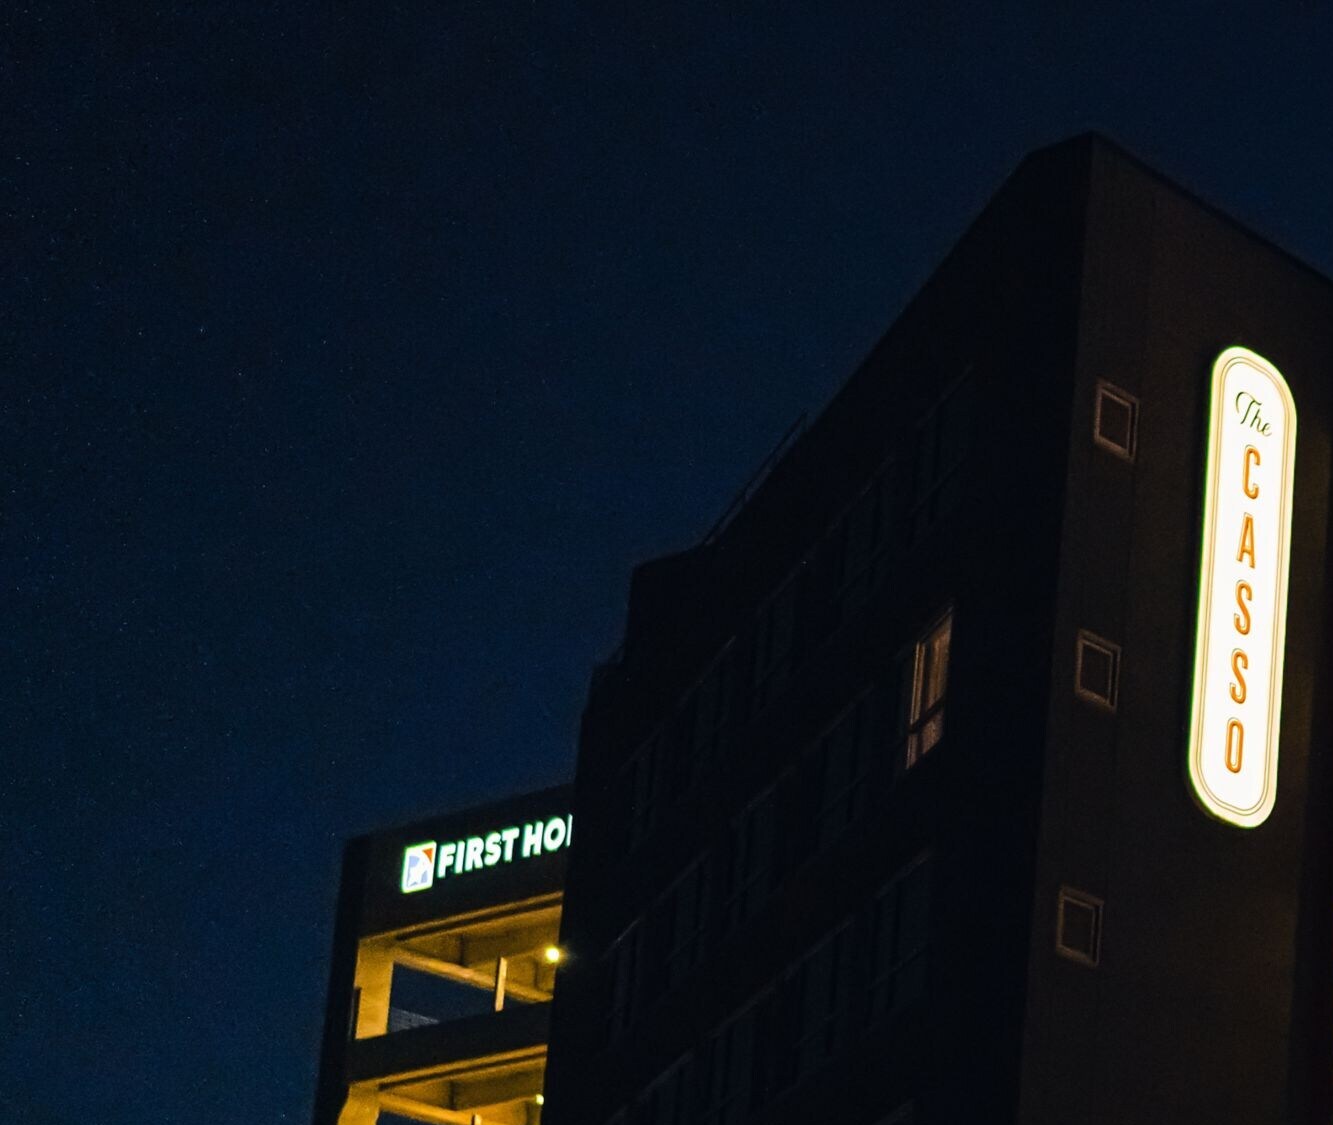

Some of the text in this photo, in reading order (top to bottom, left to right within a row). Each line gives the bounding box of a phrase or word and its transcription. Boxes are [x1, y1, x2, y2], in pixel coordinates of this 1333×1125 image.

[1235, 391, 1272, 437] The
[1224, 444, 1261, 774] CASSO
[437, 813, 573, 879] FIRST HO
